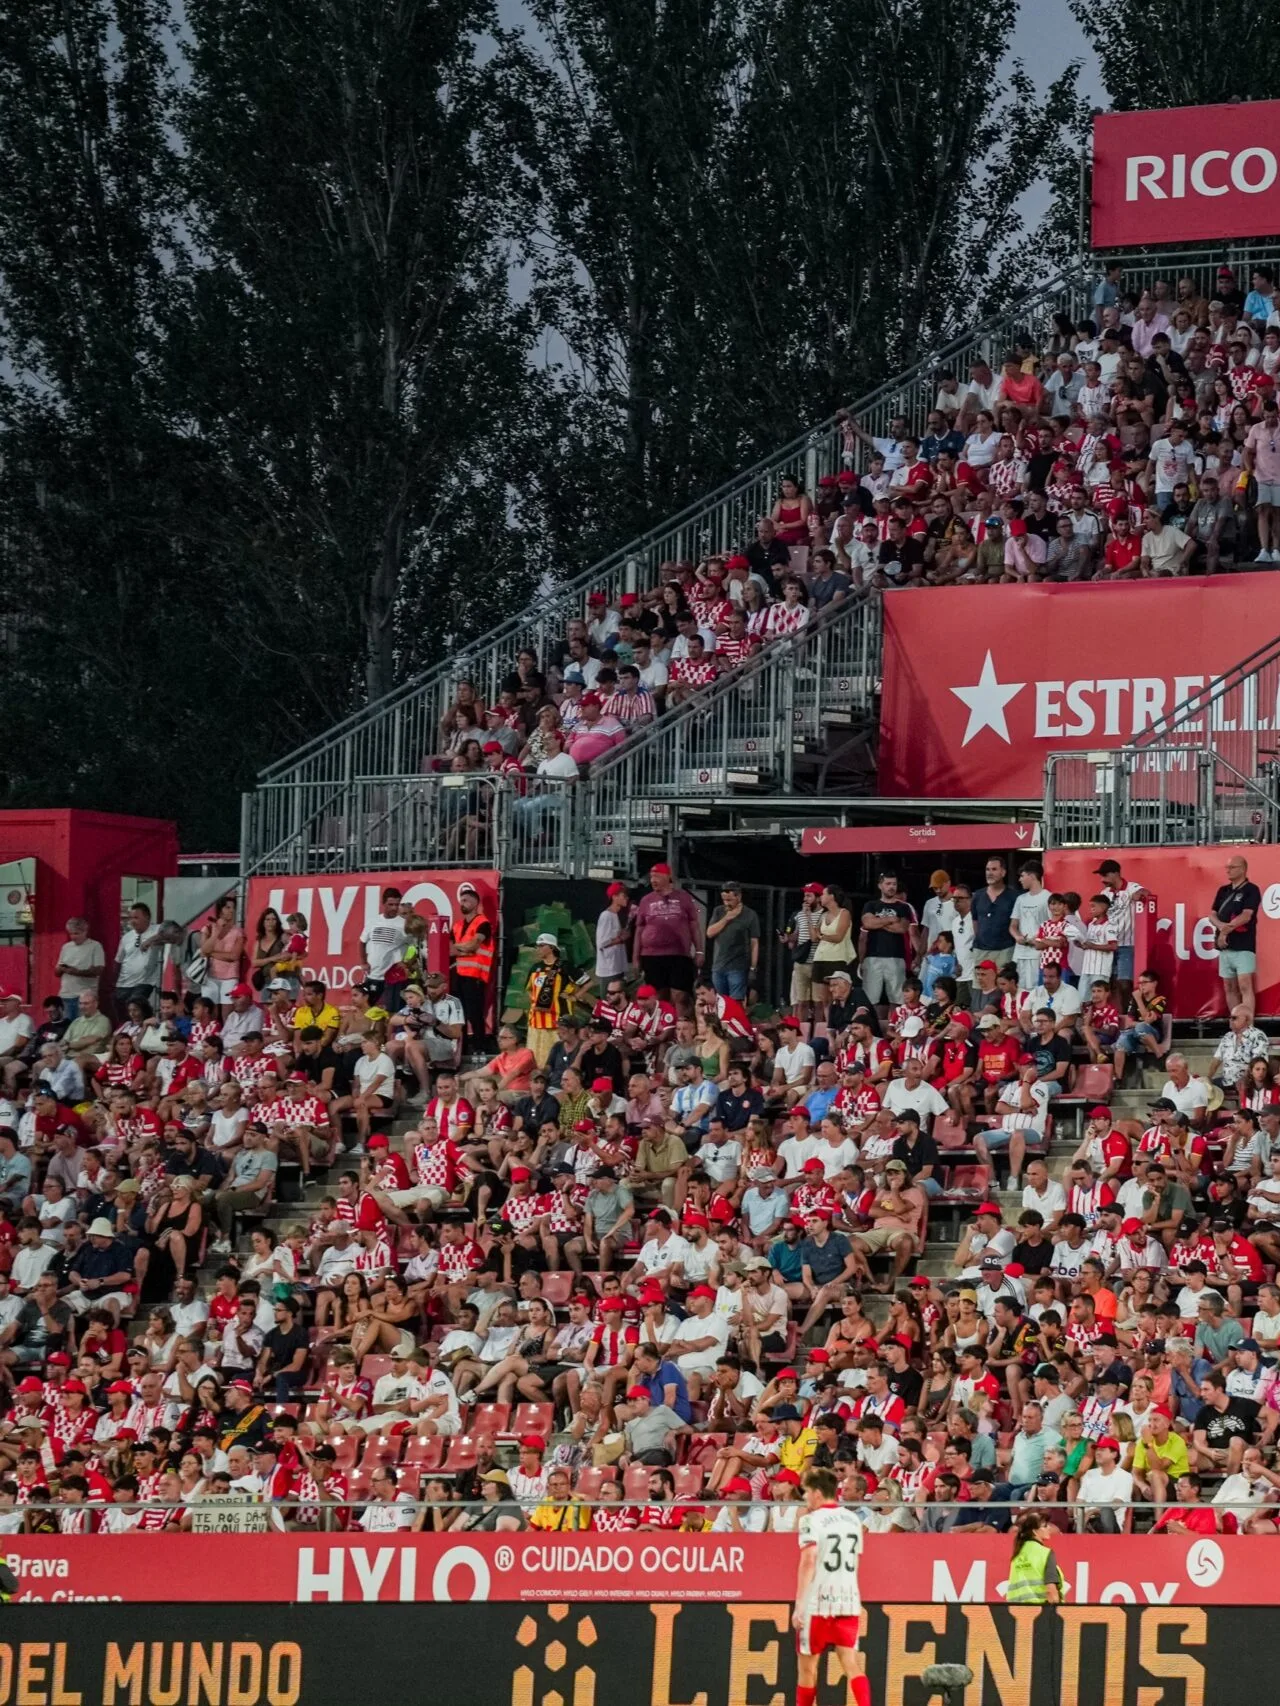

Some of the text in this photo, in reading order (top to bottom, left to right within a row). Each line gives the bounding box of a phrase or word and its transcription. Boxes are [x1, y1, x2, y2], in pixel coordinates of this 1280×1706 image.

[909, 827, 936, 837] Sortida
[1136, 901, 1144, 914] B
[1148, 901, 1156, 914] B
[429, 922, 438, 934] A
[441, 922, 450, 934] A
[195, 1513, 211, 1523] TE
[218, 1513, 240, 1524] ROG
[521, 1546, 634, 1573] CUIDADO
[640, 1546, 744, 1573] OCULAR
[824, 1534, 858, 1572] 33
[6, 1553, 69, 1578] Brava
[103, 1641, 302, 1706] MUNDO
